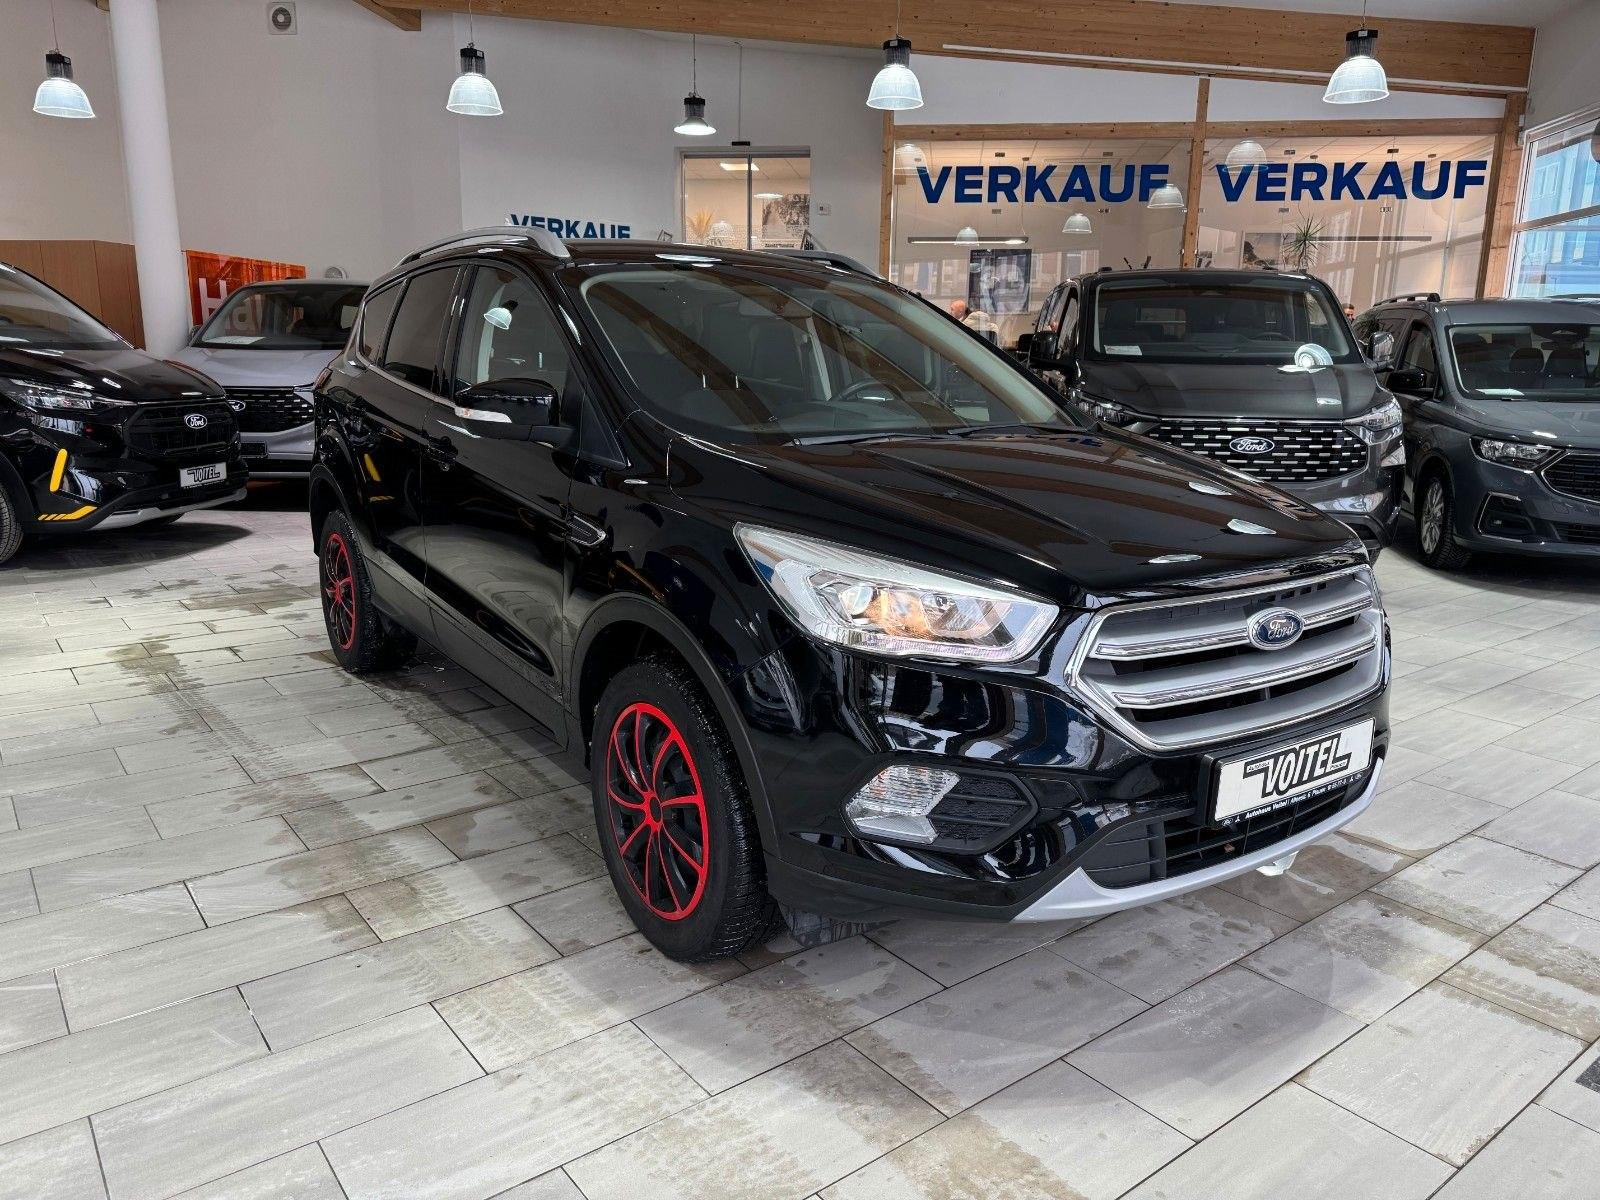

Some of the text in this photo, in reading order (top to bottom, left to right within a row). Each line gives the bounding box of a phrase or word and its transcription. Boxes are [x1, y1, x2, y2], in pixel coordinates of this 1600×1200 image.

[916, 164, 1169, 203] VERKAUF
[1216, 160, 1488, 202] VERKAUF
[1237, 438, 1267, 451] Ford
[194, 465, 217, 482] VOITEL
[1268, 618, 1294, 640] Ford
[1260, 733, 1345, 798] VOITEL
